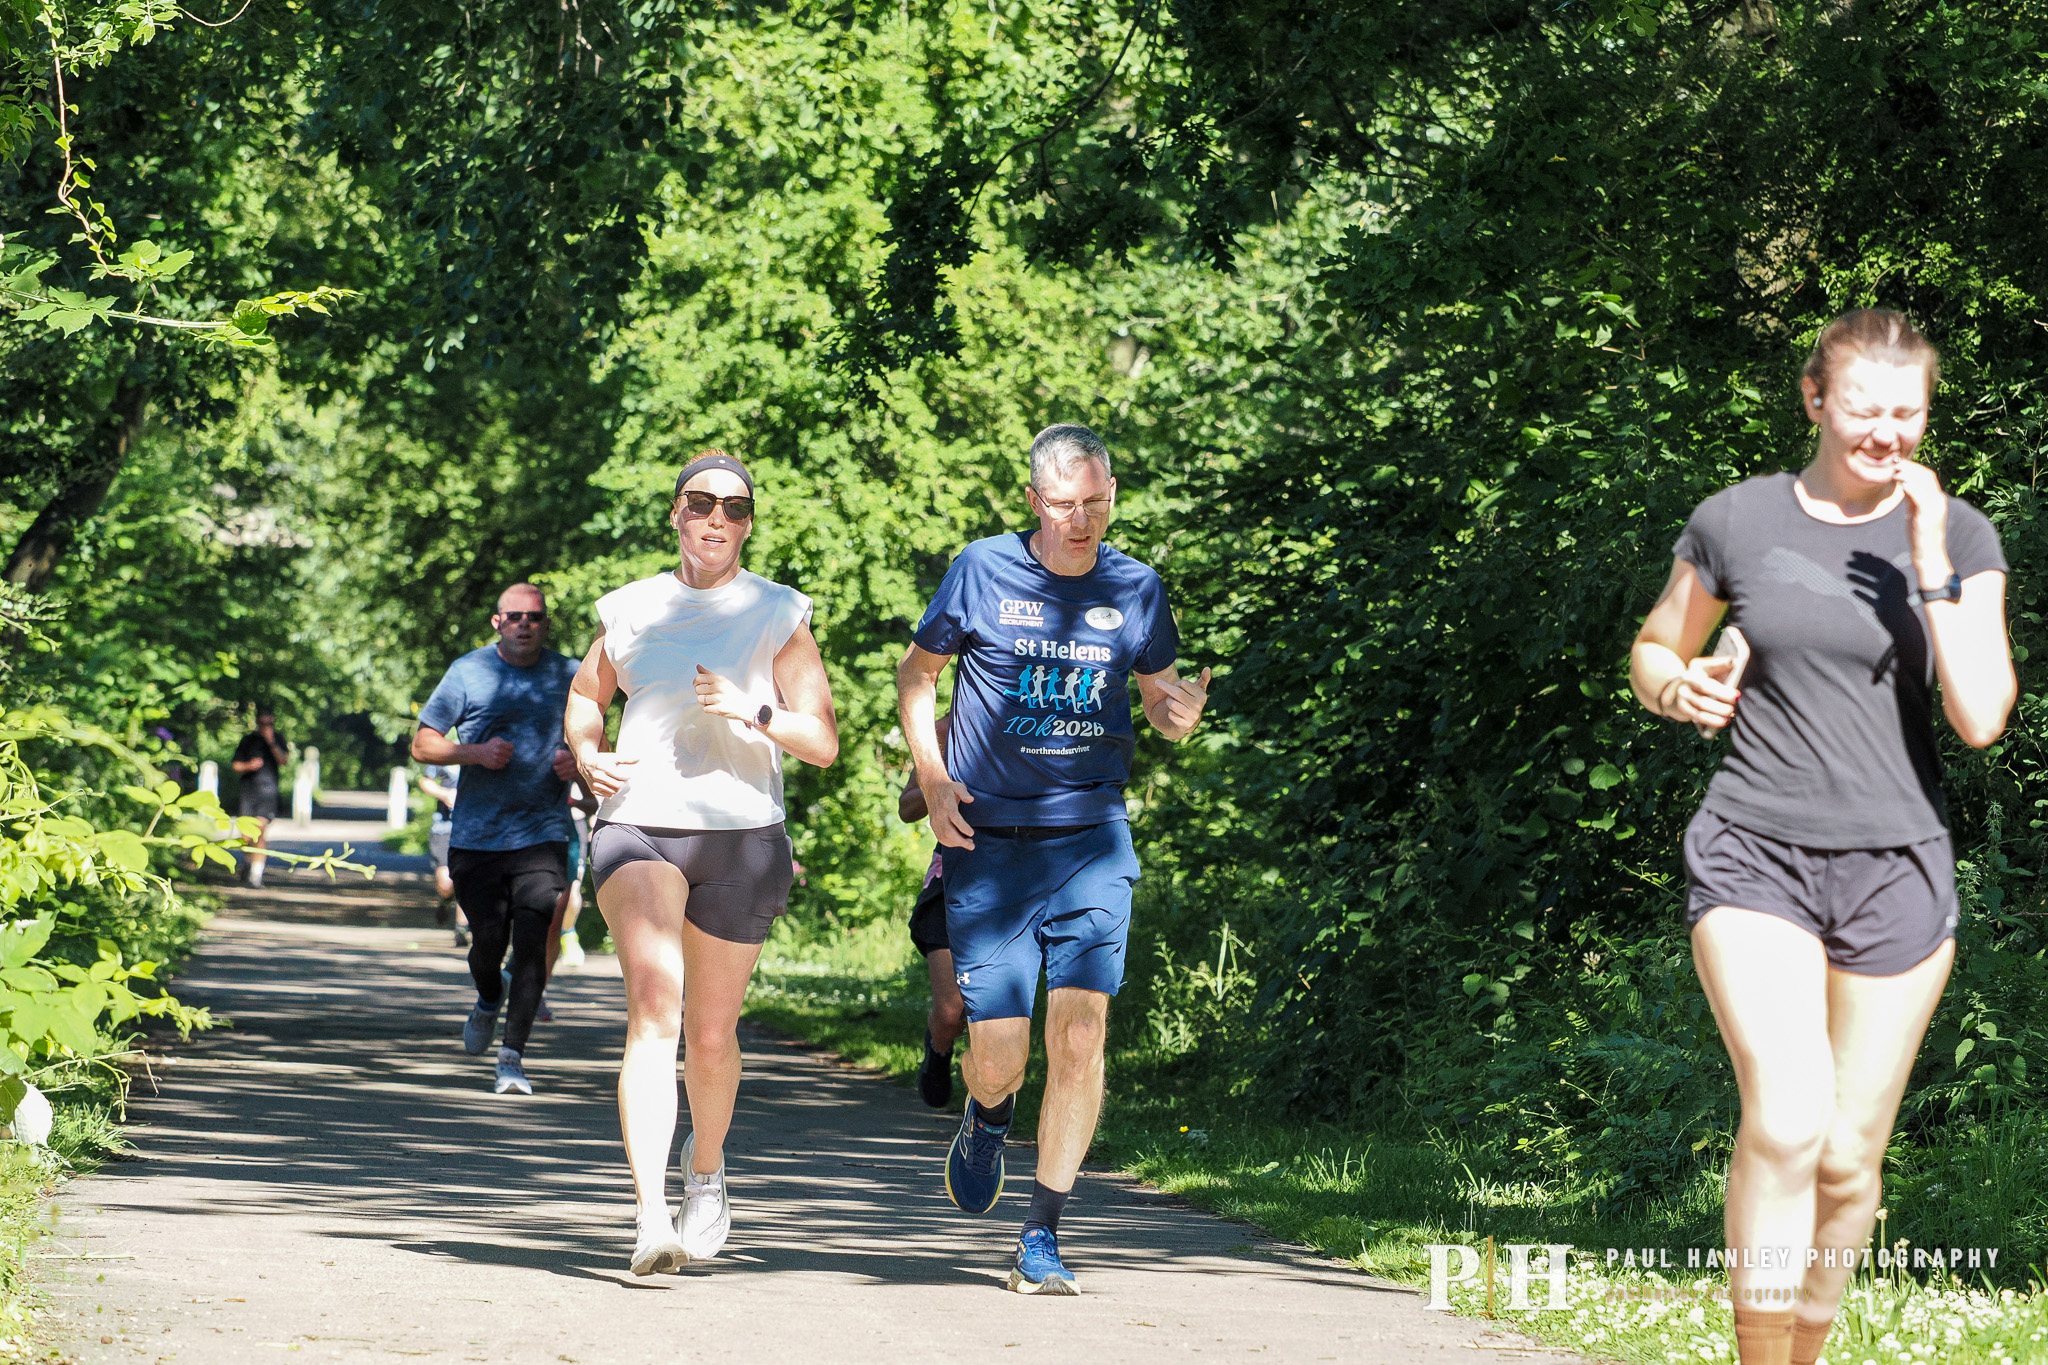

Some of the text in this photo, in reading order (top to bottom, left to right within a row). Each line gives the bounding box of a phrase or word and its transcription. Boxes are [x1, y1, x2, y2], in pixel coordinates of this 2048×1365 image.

[999, 598, 1045, 616] GPW
[998, 618, 1044, 628] RECRUITMENT
[1014, 638, 1112, 662] St Helens
